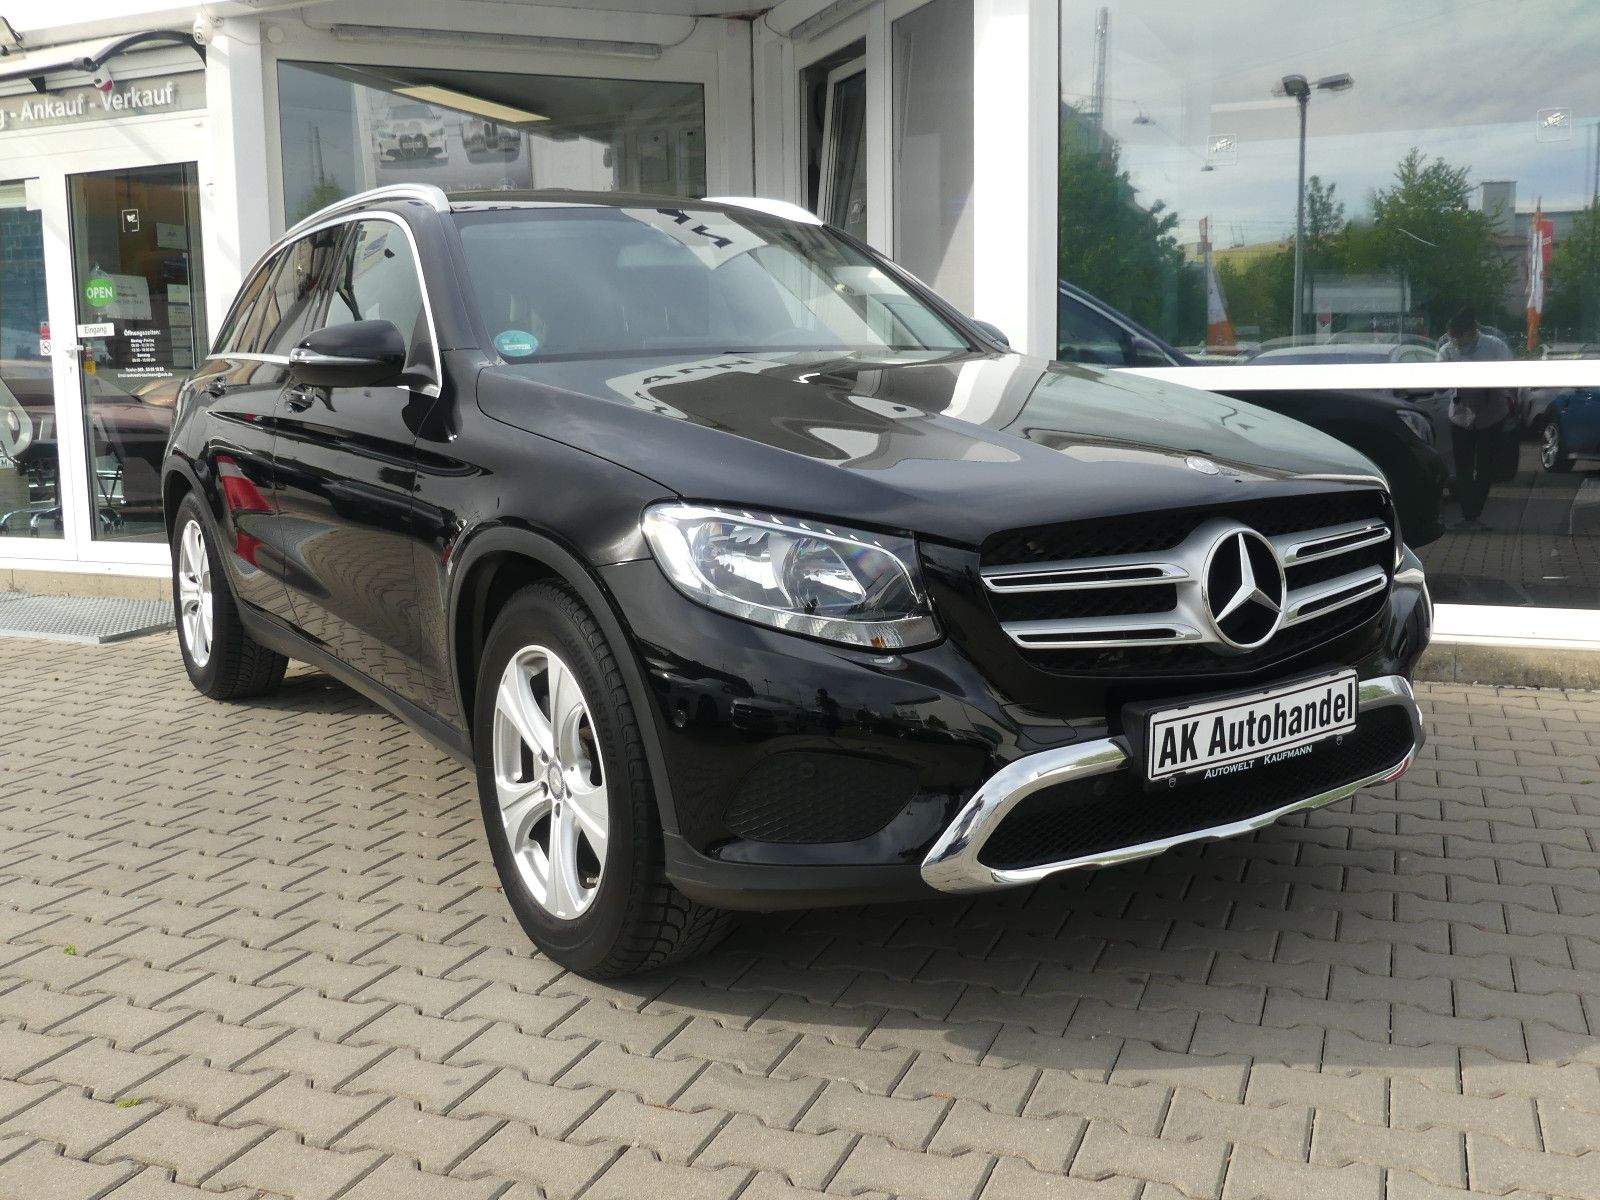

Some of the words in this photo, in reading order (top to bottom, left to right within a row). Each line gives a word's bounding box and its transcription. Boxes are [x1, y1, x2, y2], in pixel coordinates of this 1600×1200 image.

[20, 94, 84, 121] Ankauf
[100, 83, 174, 112] Verkauf
[86, 286, 113, 299] OPEN
[84, 326, 108, 335] Eingang
[1158, 721, 1199, 768] AK
[1207, 682, 1353, 757] Autohandel
[1204, 760, 1254, 780] AUTOWELT
[1263, 744, 1313, 765] KAUFMANN
